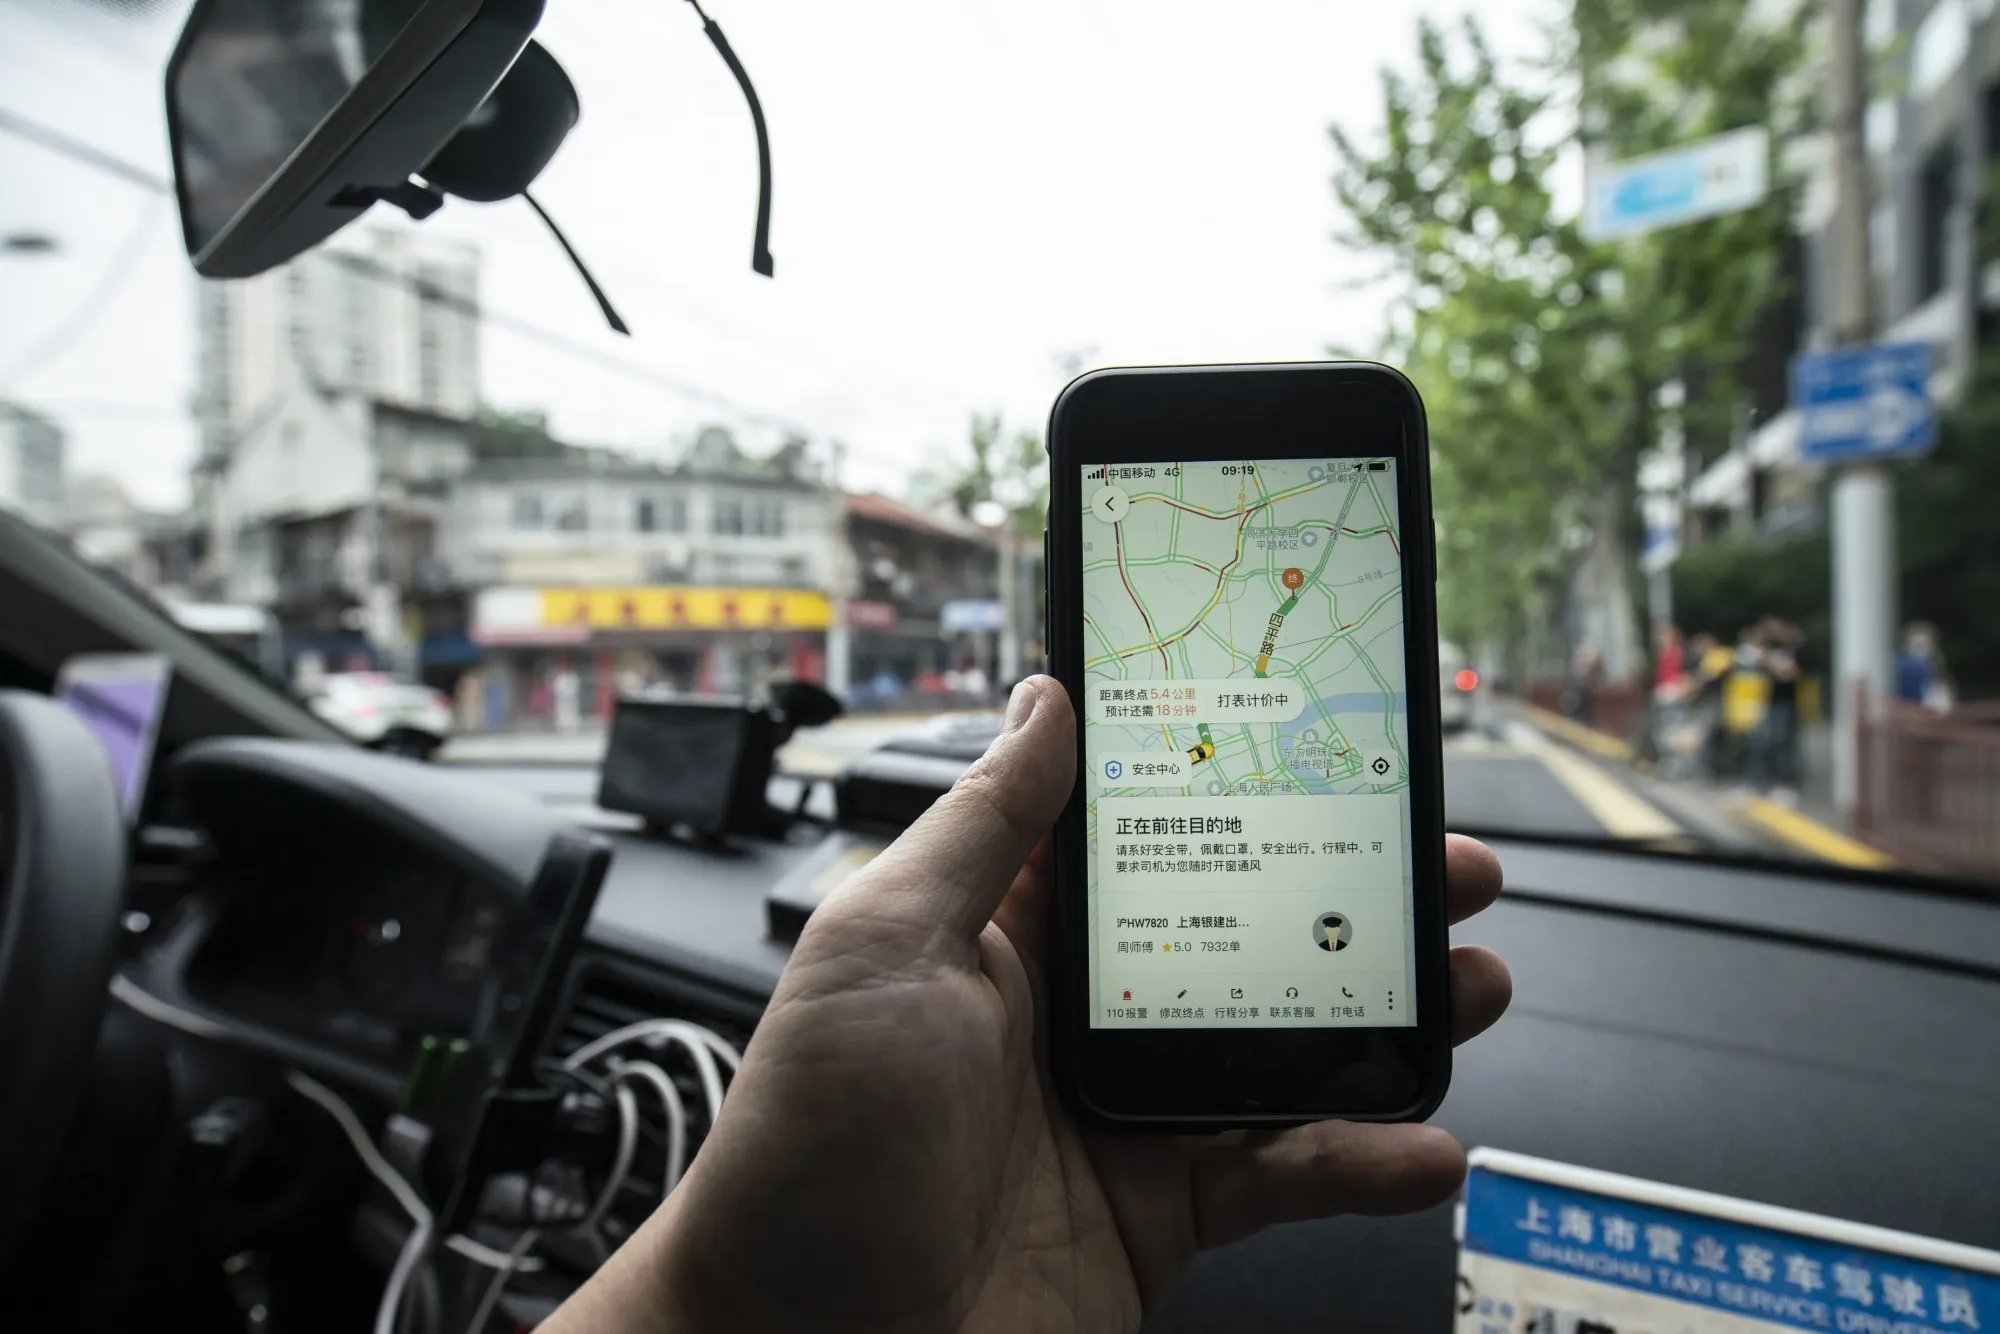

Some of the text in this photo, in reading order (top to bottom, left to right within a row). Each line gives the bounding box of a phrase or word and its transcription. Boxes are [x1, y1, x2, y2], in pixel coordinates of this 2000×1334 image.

[1109, 467, 1181, 479] 中国移动 4G
[1221, 465, 1255, 475] 09:19
[1244, 528, 1299, 539] 同济大学四
[1256, 540, 1299, 550] 平路校区
[1287, 573, 1298, 583] 终
[1260, 612, 1284, 656] 四平路
[1217, 693, 1289, 708] 打表计价中
[1132, 763, 1181, 775] 安全中心
[1290, 759, 1334, 770] 播电视塔
[1228, 781, 1292, 793] 上海人民广场
[1115, 816, 1243, 835] 正在前往目的地
[1115, 860, 1262, 873] 要求司机为您随时开窗通风
[1117, 917, 1169, 928] 沪HW7820
[1117, 941, 1241, 954] 周师傅 5.0 7932单
[1160, 1007, 1205, 1019] 修改终点
[1214, 1007, 1260, 1019] 行程分享
[1269, 1006, 1316, 1019] 联系客服
[1330, 1006, 1365, 1019] 打电话
[1515, 1197, 1981, 1330] 上海市营业客车驾驶员
[1656, 1265, 1713, 1298] TAXI
[1716, 1280, 1830, 1328] SERVICE
